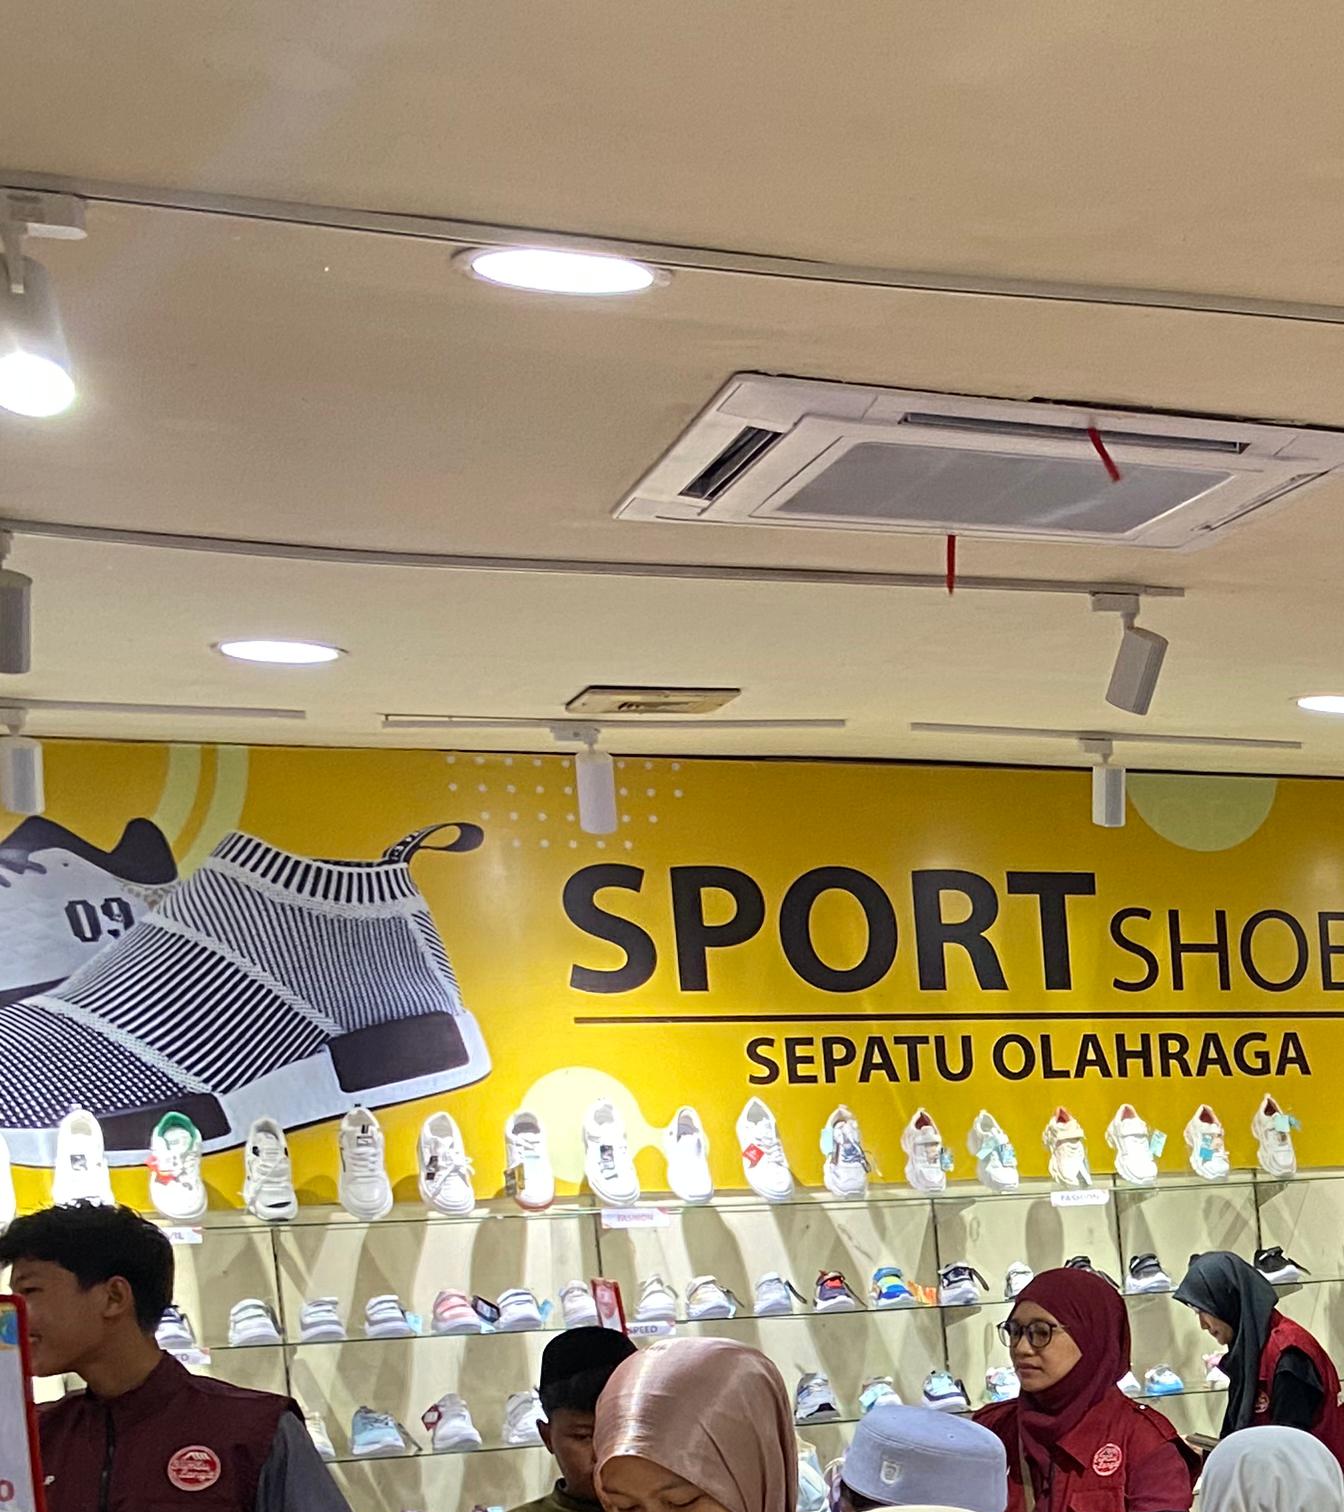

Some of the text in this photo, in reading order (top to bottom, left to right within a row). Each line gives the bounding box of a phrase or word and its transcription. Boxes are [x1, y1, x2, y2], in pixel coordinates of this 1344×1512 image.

[65, 897, 135, 943] 09
[563, 862, 1096, 993] SPORT
[746, 1031, 1312, 1085] SEPATU OLAHRAGA
